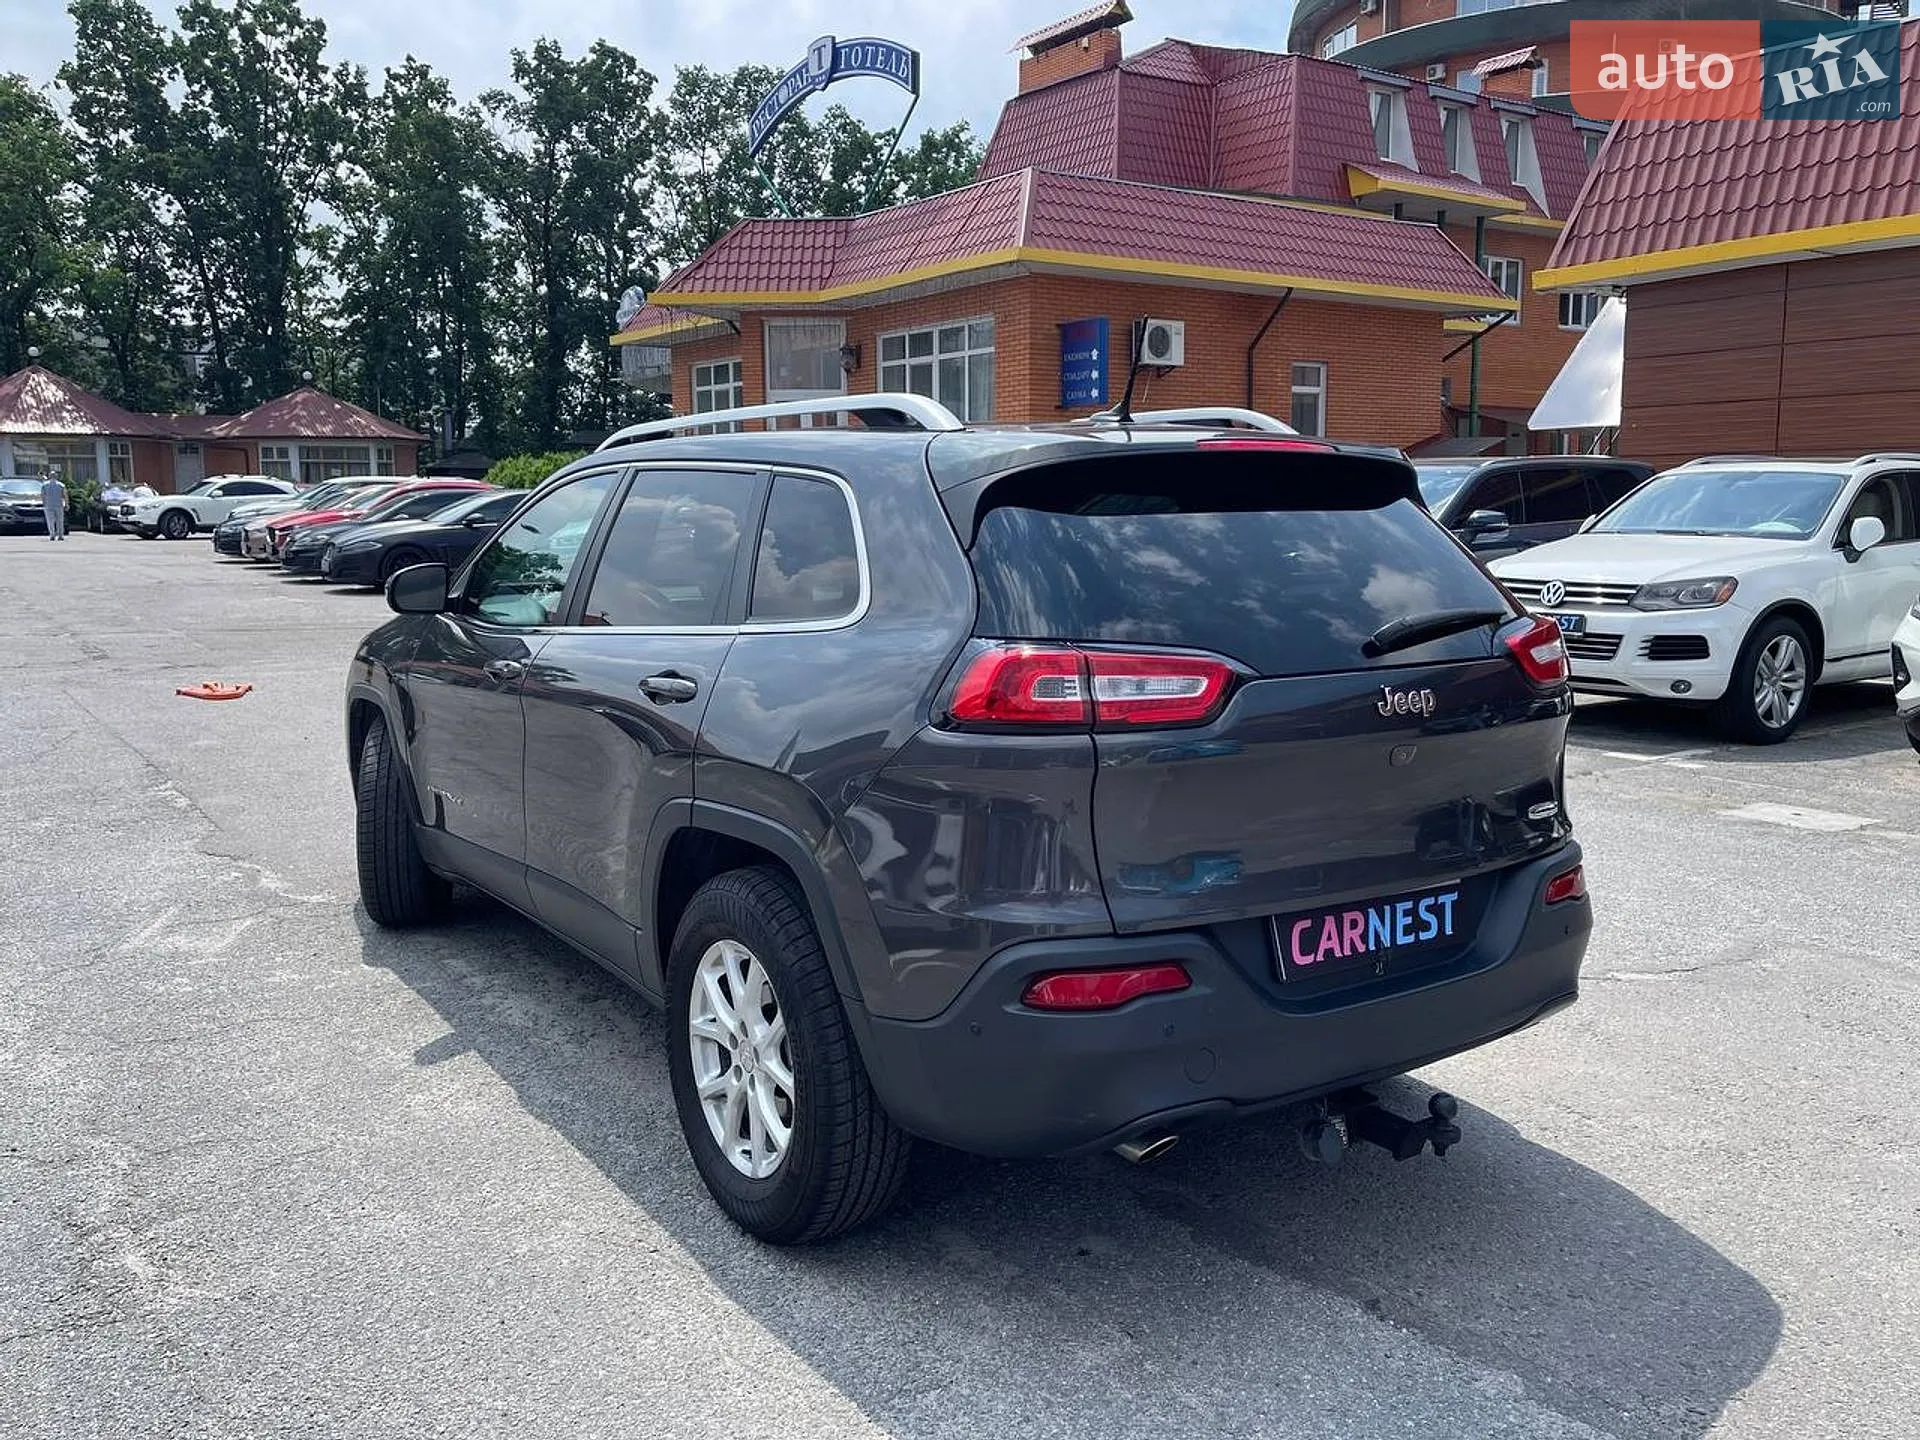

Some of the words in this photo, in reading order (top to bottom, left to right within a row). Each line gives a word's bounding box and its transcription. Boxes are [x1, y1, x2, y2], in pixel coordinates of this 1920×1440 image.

[839, 47, 909, 78] ГОТЕЛЬ
[1377, 684, 1436, 717] Jeep
[1291, 891, 1458, 966] CARNEST
